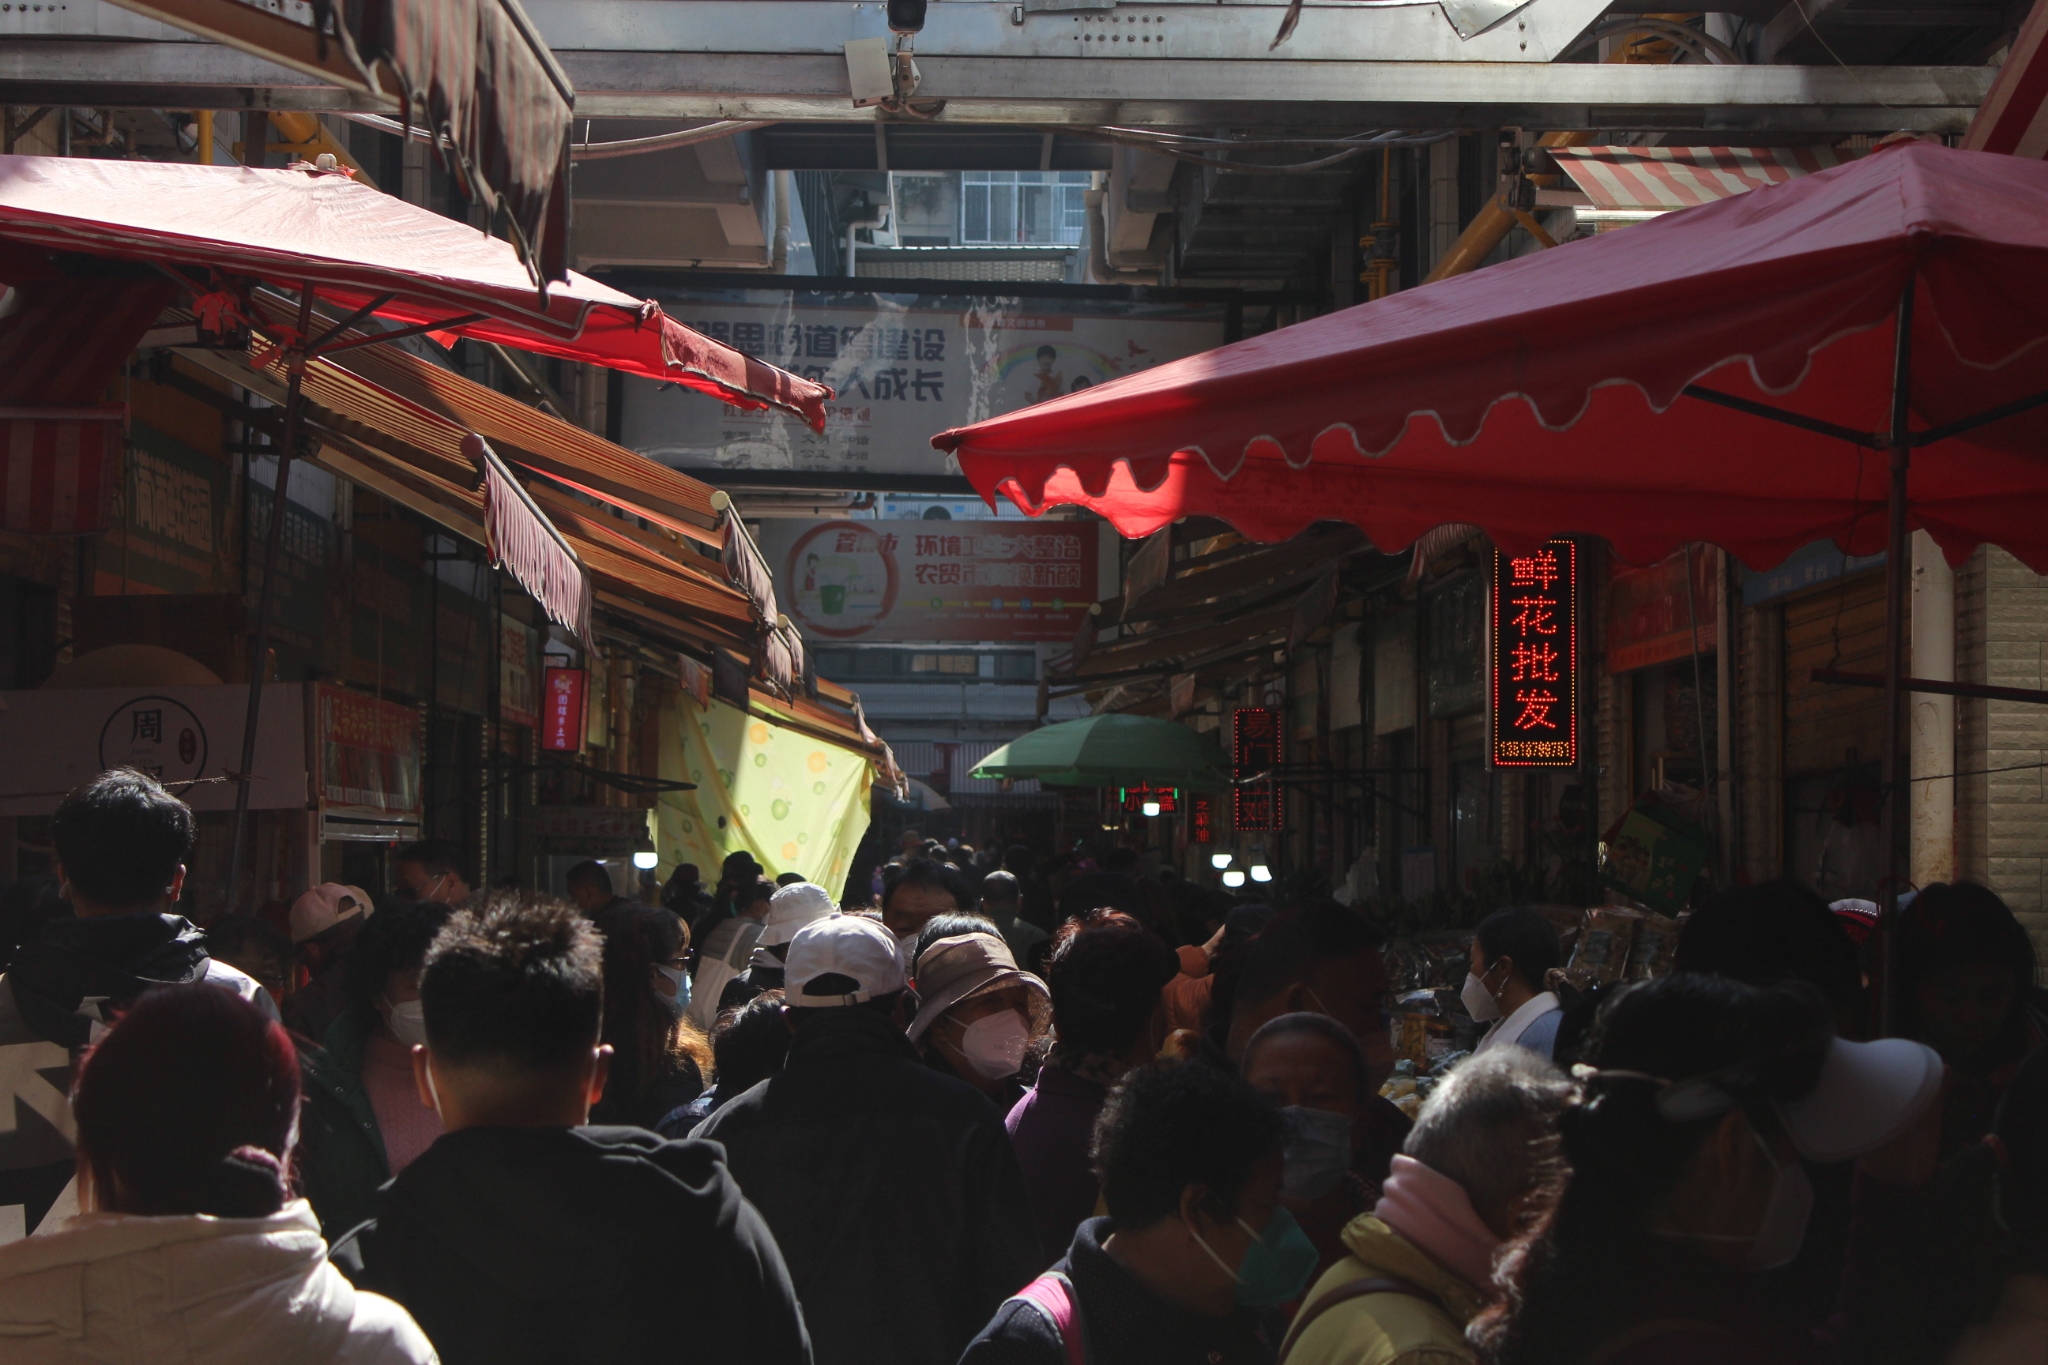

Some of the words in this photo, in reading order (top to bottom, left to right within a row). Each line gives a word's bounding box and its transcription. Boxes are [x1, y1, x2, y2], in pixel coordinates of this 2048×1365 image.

[682, 320, 946, 361] 强思想道德建设
[1510, 549, 1560, 731] 鲜花批发
